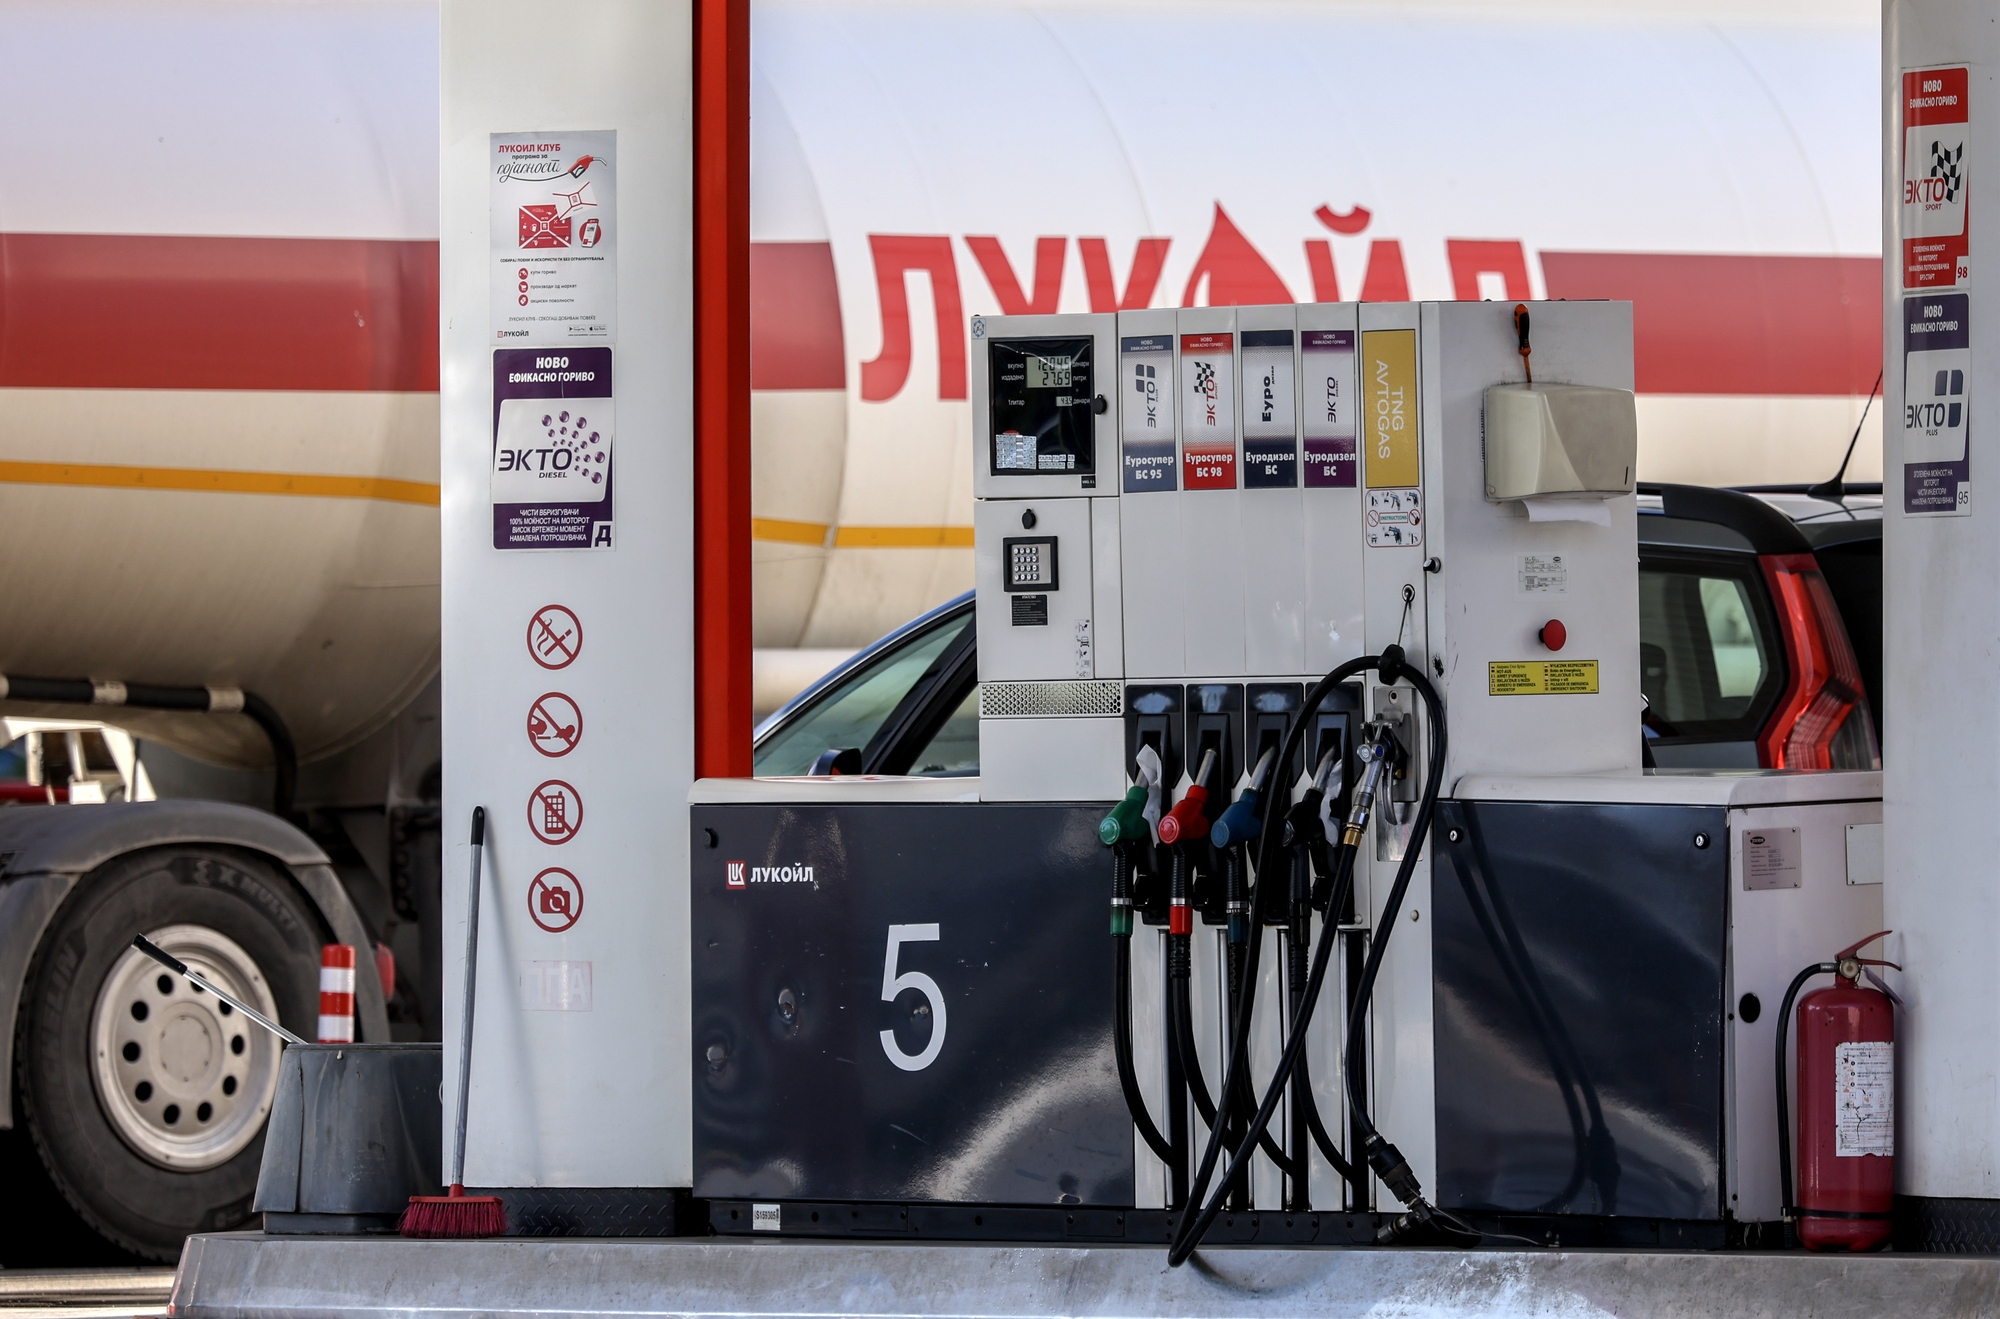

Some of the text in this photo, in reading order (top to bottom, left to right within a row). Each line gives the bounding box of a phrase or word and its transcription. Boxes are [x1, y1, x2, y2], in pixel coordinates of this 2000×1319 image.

[1923, 80, 1942, 92] НОВО
[1936, 95, 1957, 106] ГОРИВО
[498, 144, 560, 153] ЛУКОИЛ КЛУБ
[1905, 178, 1945, 204] ЭКТО
[1958, 267, 1968, 278] 98
[1924, 305, 1943, 318] НОВО
[1936, 321, 1958, 331] ГОРИВО
[536, 356, 569, 369] НОВО
[509, 372, 595, 383] ЕФИКАСНО ГОРИВО
[1147, 381, 1156, 428] ЭКТО
[1206, 379, 1216, 426] ЭКТО
[1262, 376, 1274, 422] Еуро
[1327, 377, 1337, 423] ЭКТО
[1376, 360, 1391, 459] AVTOGAS
[1392, 387, 1404, 431] TNG
[1906, 403, 1945, 428] ЭКТО
[498, 448, 572, 471] ЭКТО
[1126, 456, 1174, 467] Еуросупер
[1186, 453, 1233, 464] Еуросупер
[1246, 452, 1294, 464] Еуродизел
[1304, 451, 1356, 463] Еуродизел
[1136, 469, 1162, 480] БС 95
[1197, 467, 1222, 477] БС 98
[1265, 465, 1277, 475] БС
[1324, 466, 1337, 476] БС
[1958, 491, 1968, 504] 95
[524, 517, 551, 525] МОЌНОСТ
[595, 525, 612, 547] Д
[751, 862, 814, 883] ЛУКОЙЛ
[880, 923, 947, 1071] 5
